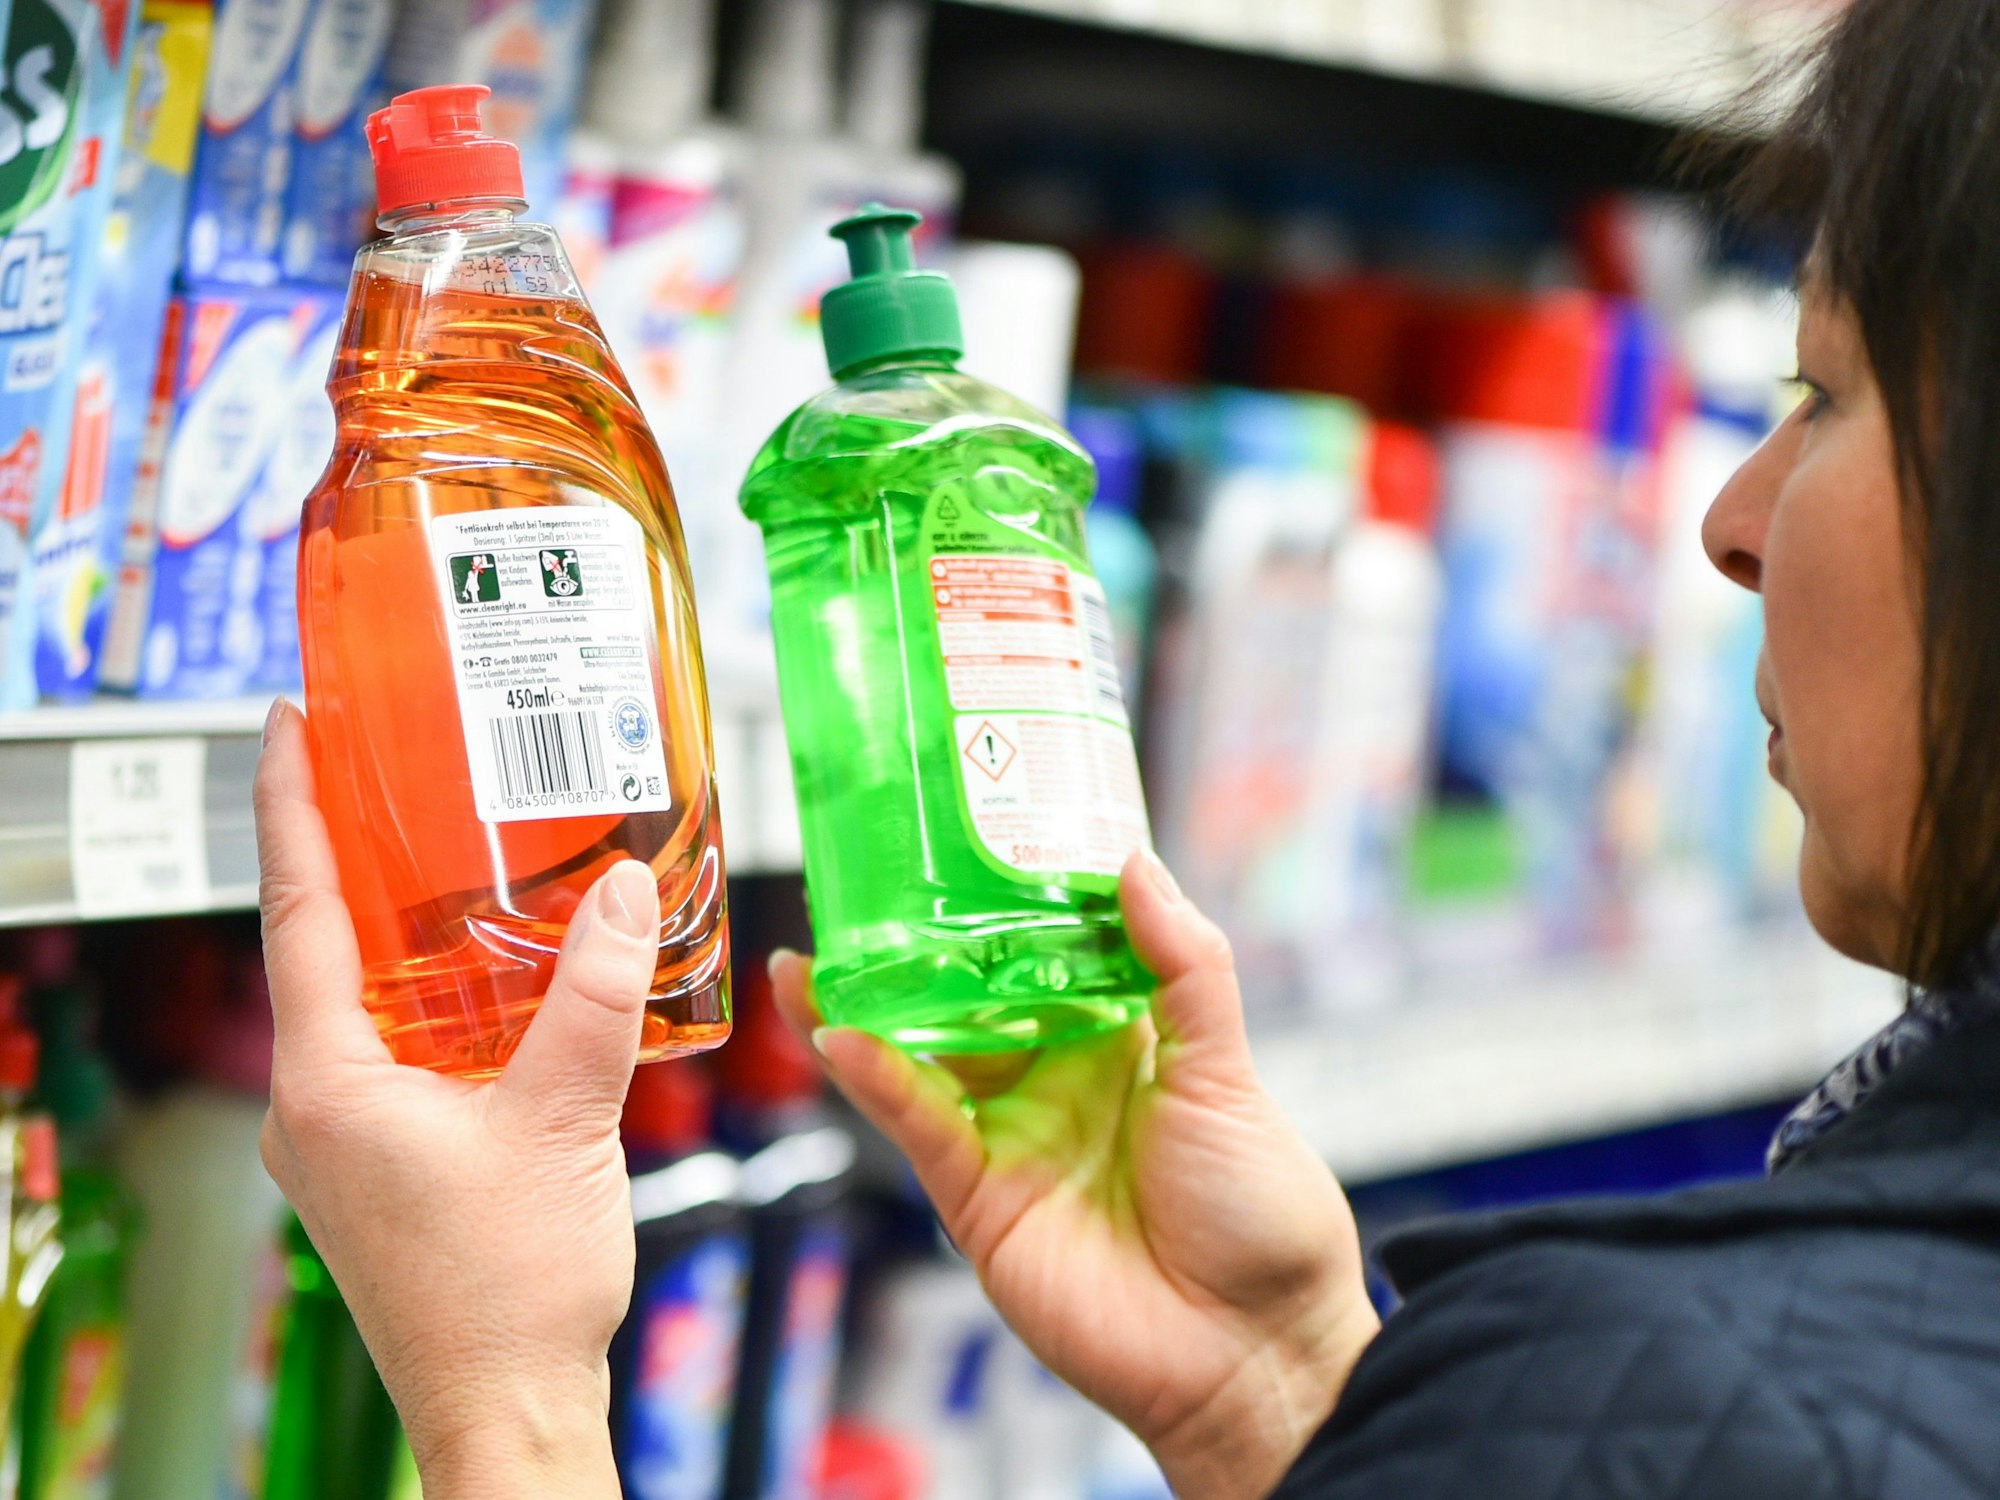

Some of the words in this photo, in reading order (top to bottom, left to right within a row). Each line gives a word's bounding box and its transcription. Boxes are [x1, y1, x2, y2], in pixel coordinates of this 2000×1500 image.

[506, 521, 526, 531] selbst
[527, 520, 538, 529] bei
[539, 519, 580, 531] Temperaturen
[473, 535, 507, 546] Dosierung:
[514, 532, 536, 544] Spritzer
[537, 531, 555, 544] (3ml)
[556, 534, 566, 543] pro
[512, 551, 537, 562] Reichweite
[499, 567, 508, 575] von
[509, 564, 528, 574] Kindern
[459, 600, 527, 615] www.cleanright.eu
[493, 658, 511, 667] Gratis
[511, 655, 528, 665] 0800
[530, 652, 558, 663] 0032479
[488, 668, 506, 678] Gamble
[1012, 844, 1041, 866] 500
